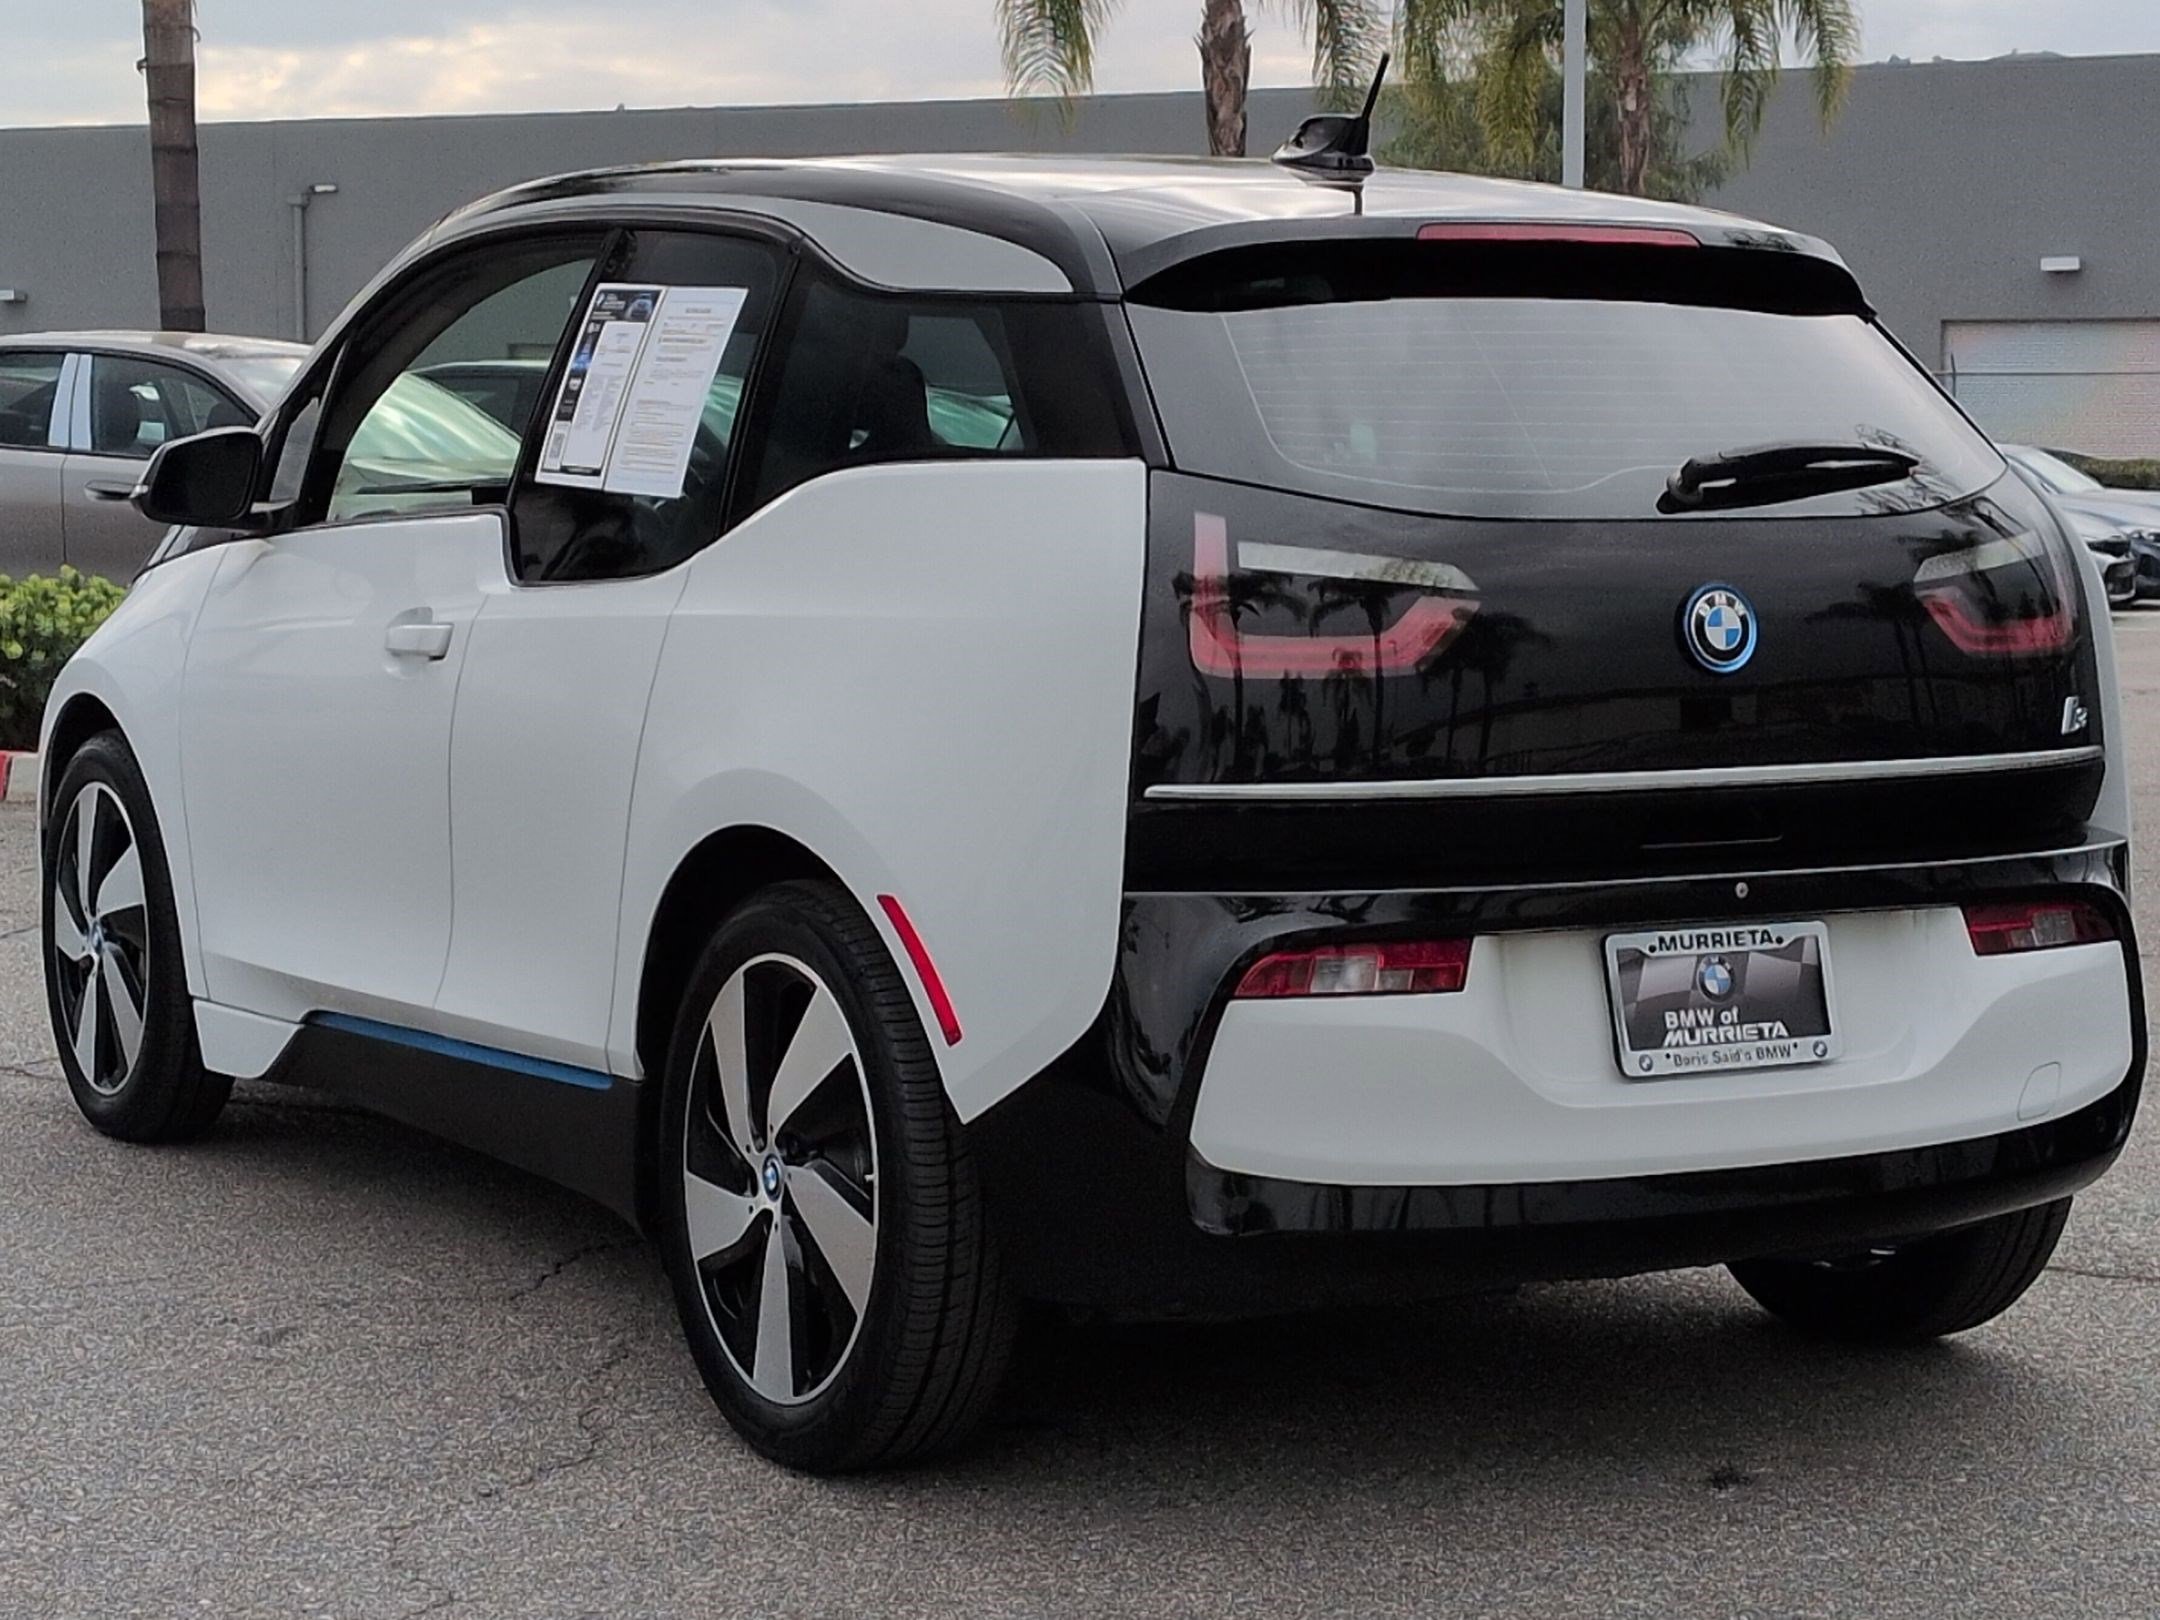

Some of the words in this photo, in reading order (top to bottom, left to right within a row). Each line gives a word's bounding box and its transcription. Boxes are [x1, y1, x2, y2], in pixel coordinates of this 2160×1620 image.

[1658, 929, 1774, 952] MURRIETA
[1665, 1006, 1714, 1029] BMW
[1720, 1005, 1739, 1025] of
[1663, 1021, 1789, 1048] MURRIETA
[1756, 1043, 1791, 1061] BMW
